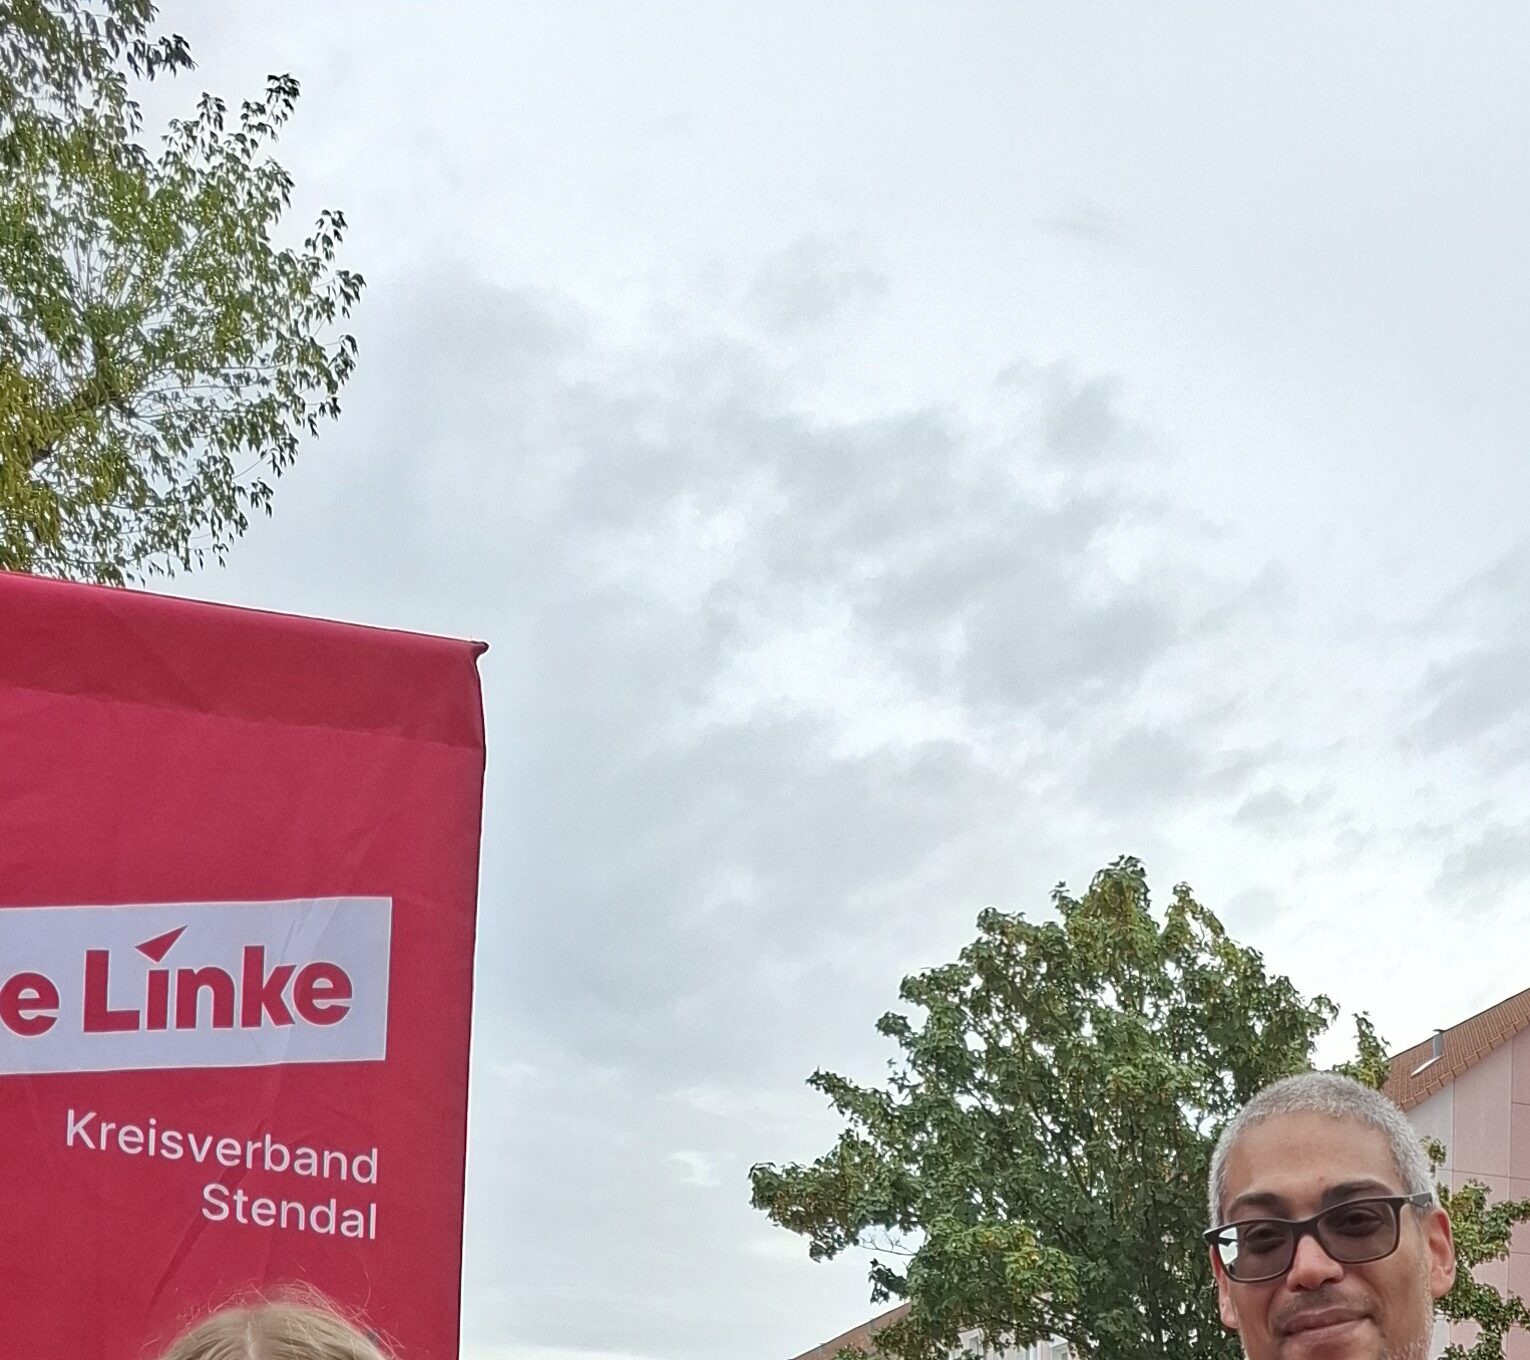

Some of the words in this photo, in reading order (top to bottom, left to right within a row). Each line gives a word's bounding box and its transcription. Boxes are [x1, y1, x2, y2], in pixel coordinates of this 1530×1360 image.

[83, 925, 353, 1033] Linke
[65, 1108, 379, 1185] Kreisverband
[201, 1182, 377, 1240] Stendal
